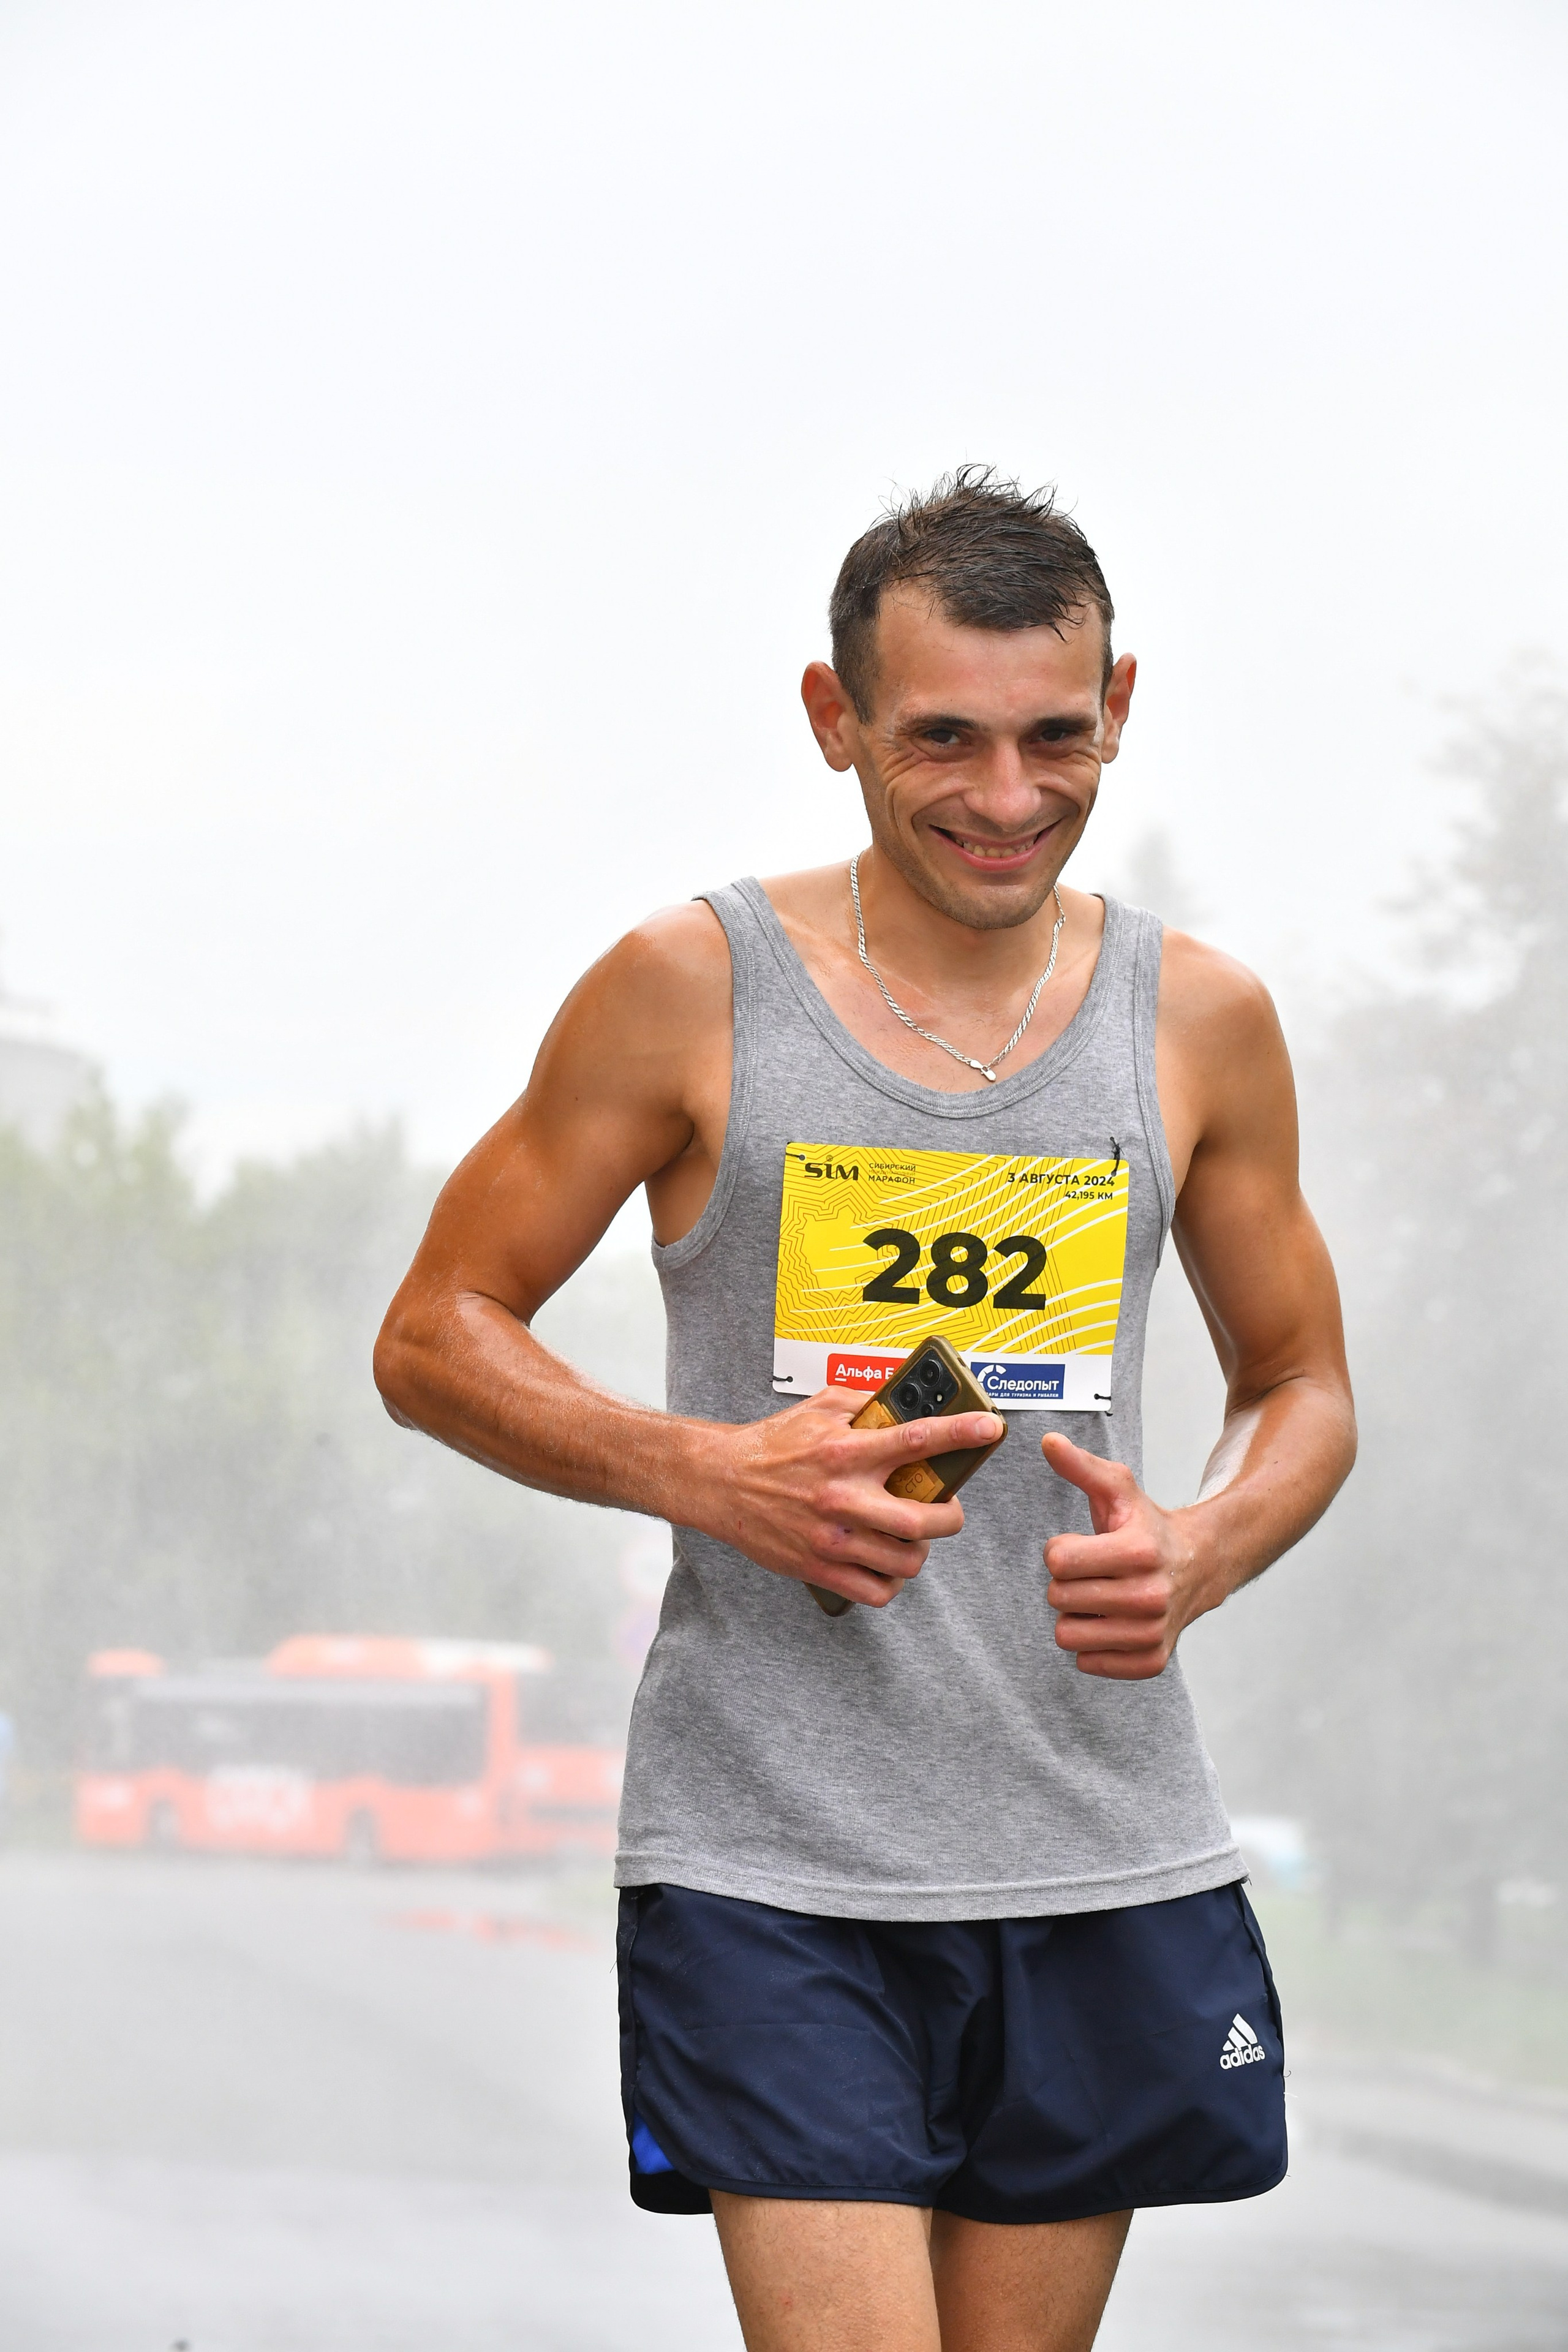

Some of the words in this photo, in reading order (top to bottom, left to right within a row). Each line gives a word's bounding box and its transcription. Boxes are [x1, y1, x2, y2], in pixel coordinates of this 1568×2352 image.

[869, 1163, 916, 1172] СИБИРСКИЙ
[869, 1175, 915, 1184] МАРАФОН
[1008, 1172, 1015, 1183] 3
[1019, 1173, 1080, 1185] АВГУСТА
[1084, 1175, 1115, 1186] 2024
[1065, 1191, 1095, 1200] 42,195
[862, 1228, 1047, 1310] 282
[835, 1363, 882, 1382] Альфа
[987, 1376, 1060, 1391] Следопыт
[905, 1473, 923, 1493] СТО
[1219, 2045, 1265, 2070] adidas
